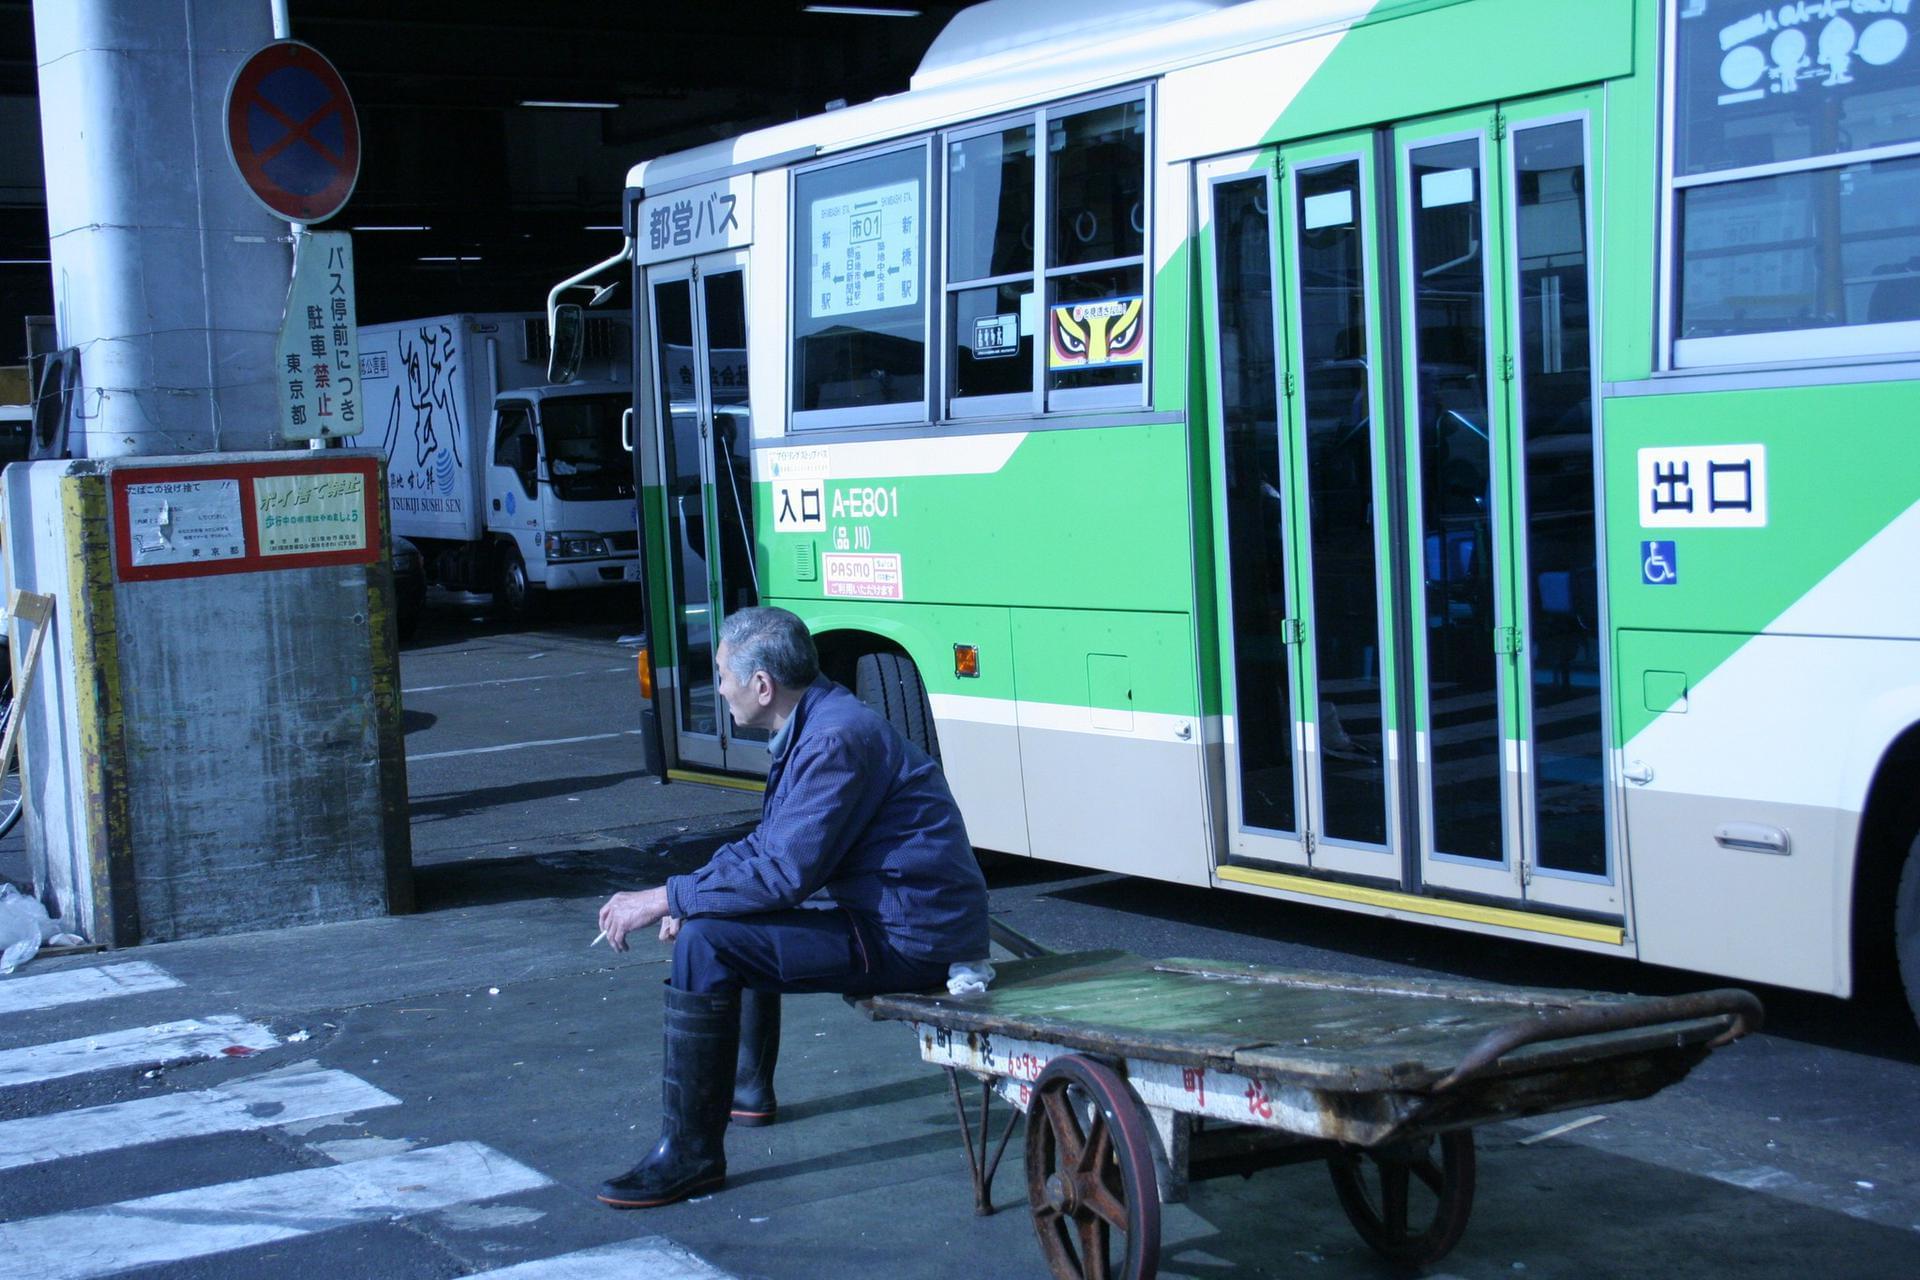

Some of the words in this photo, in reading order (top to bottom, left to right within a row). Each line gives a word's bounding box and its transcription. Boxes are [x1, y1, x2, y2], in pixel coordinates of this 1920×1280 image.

[650, 191, 738, 250] 都営バス
[852, 215, 879, 239] 市01
[821, 231, 832, 310] 新橋駅
[846, 247, 854, 306] 朝日新聞社
[901, 215, 913, 298] 新橋駅
[306, 304, 334, 417] 駐車禁止
[327, 246, 355, 422] バス停前につき
[286, 352, 308, 426] 東京都
[126, 482, 202, 496] たばこの投げ捨て
[391, 496, 420, 515] TSUKIJI
[421, 498, 444, 512] SUSHI
[445, 498, 463, 512] SEN
[779, 487, 821, 523] 入口
[831, 486, 898, 519] A-E801
[1651, 457, 1752, 513] 出口
[831, 562, 870, 578] PASMO
[831, 582, 895, 596] ご利用いただけます
